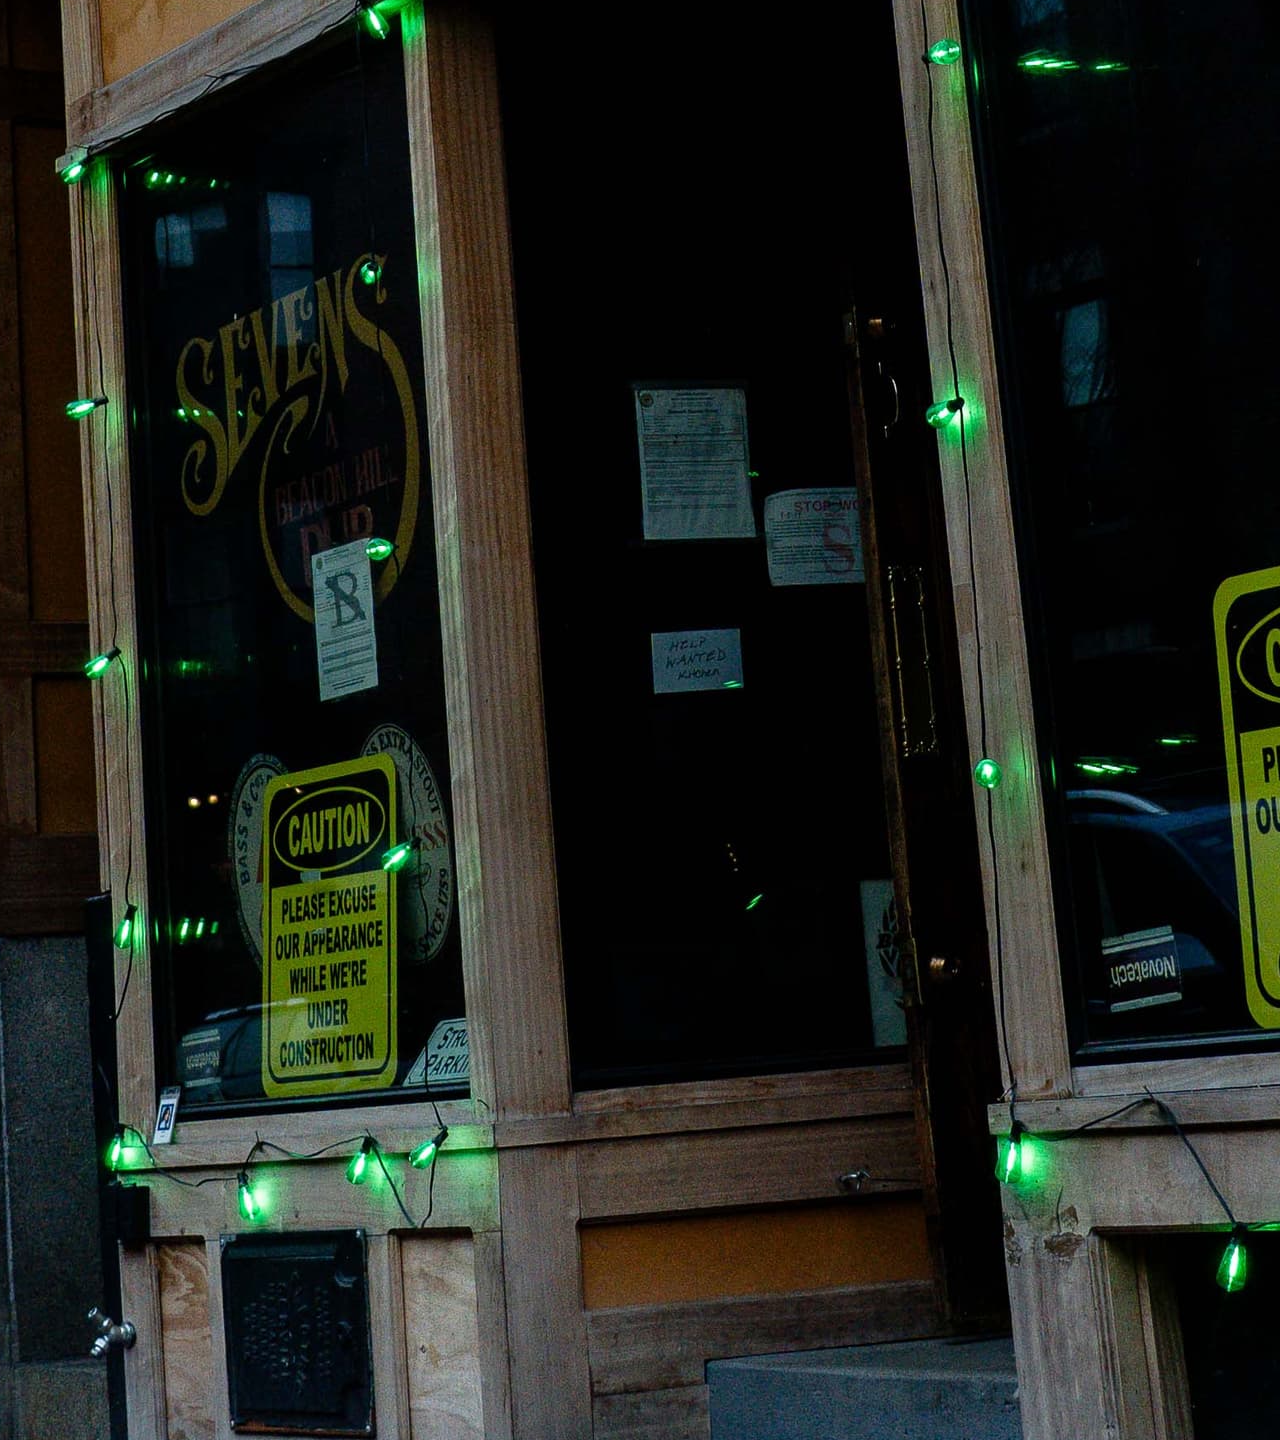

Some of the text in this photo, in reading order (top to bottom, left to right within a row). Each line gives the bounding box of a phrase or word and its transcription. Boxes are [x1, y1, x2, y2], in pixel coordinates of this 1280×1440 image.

[175, 250, 410, 520] SEVENS
[275, 444, 401, 527] BEACON HILL
[666, 647, 726, 669] WANTED
[669, 637, 706, 651] HELP
[378, 730, 413, 754] EXTRA
[414, 755, 441, 814] STOUT
[288, 801, 370, 858] CAUTION
[236, 823, 251, 885] BASS
[281, 885, 376, 924] PLEASE EXCUSE
[438, 867, 449, 907] 1759
[275, 921, 383, 960] OUR APPEARANCE
[289, 959, 367, 991] WHILE WE'RE
[1110, 955, 1176, 988] Novatech
[307, 999, 348, 1029] UNDER
[279, 1032, 374, 1068] CONSTRUCTION
